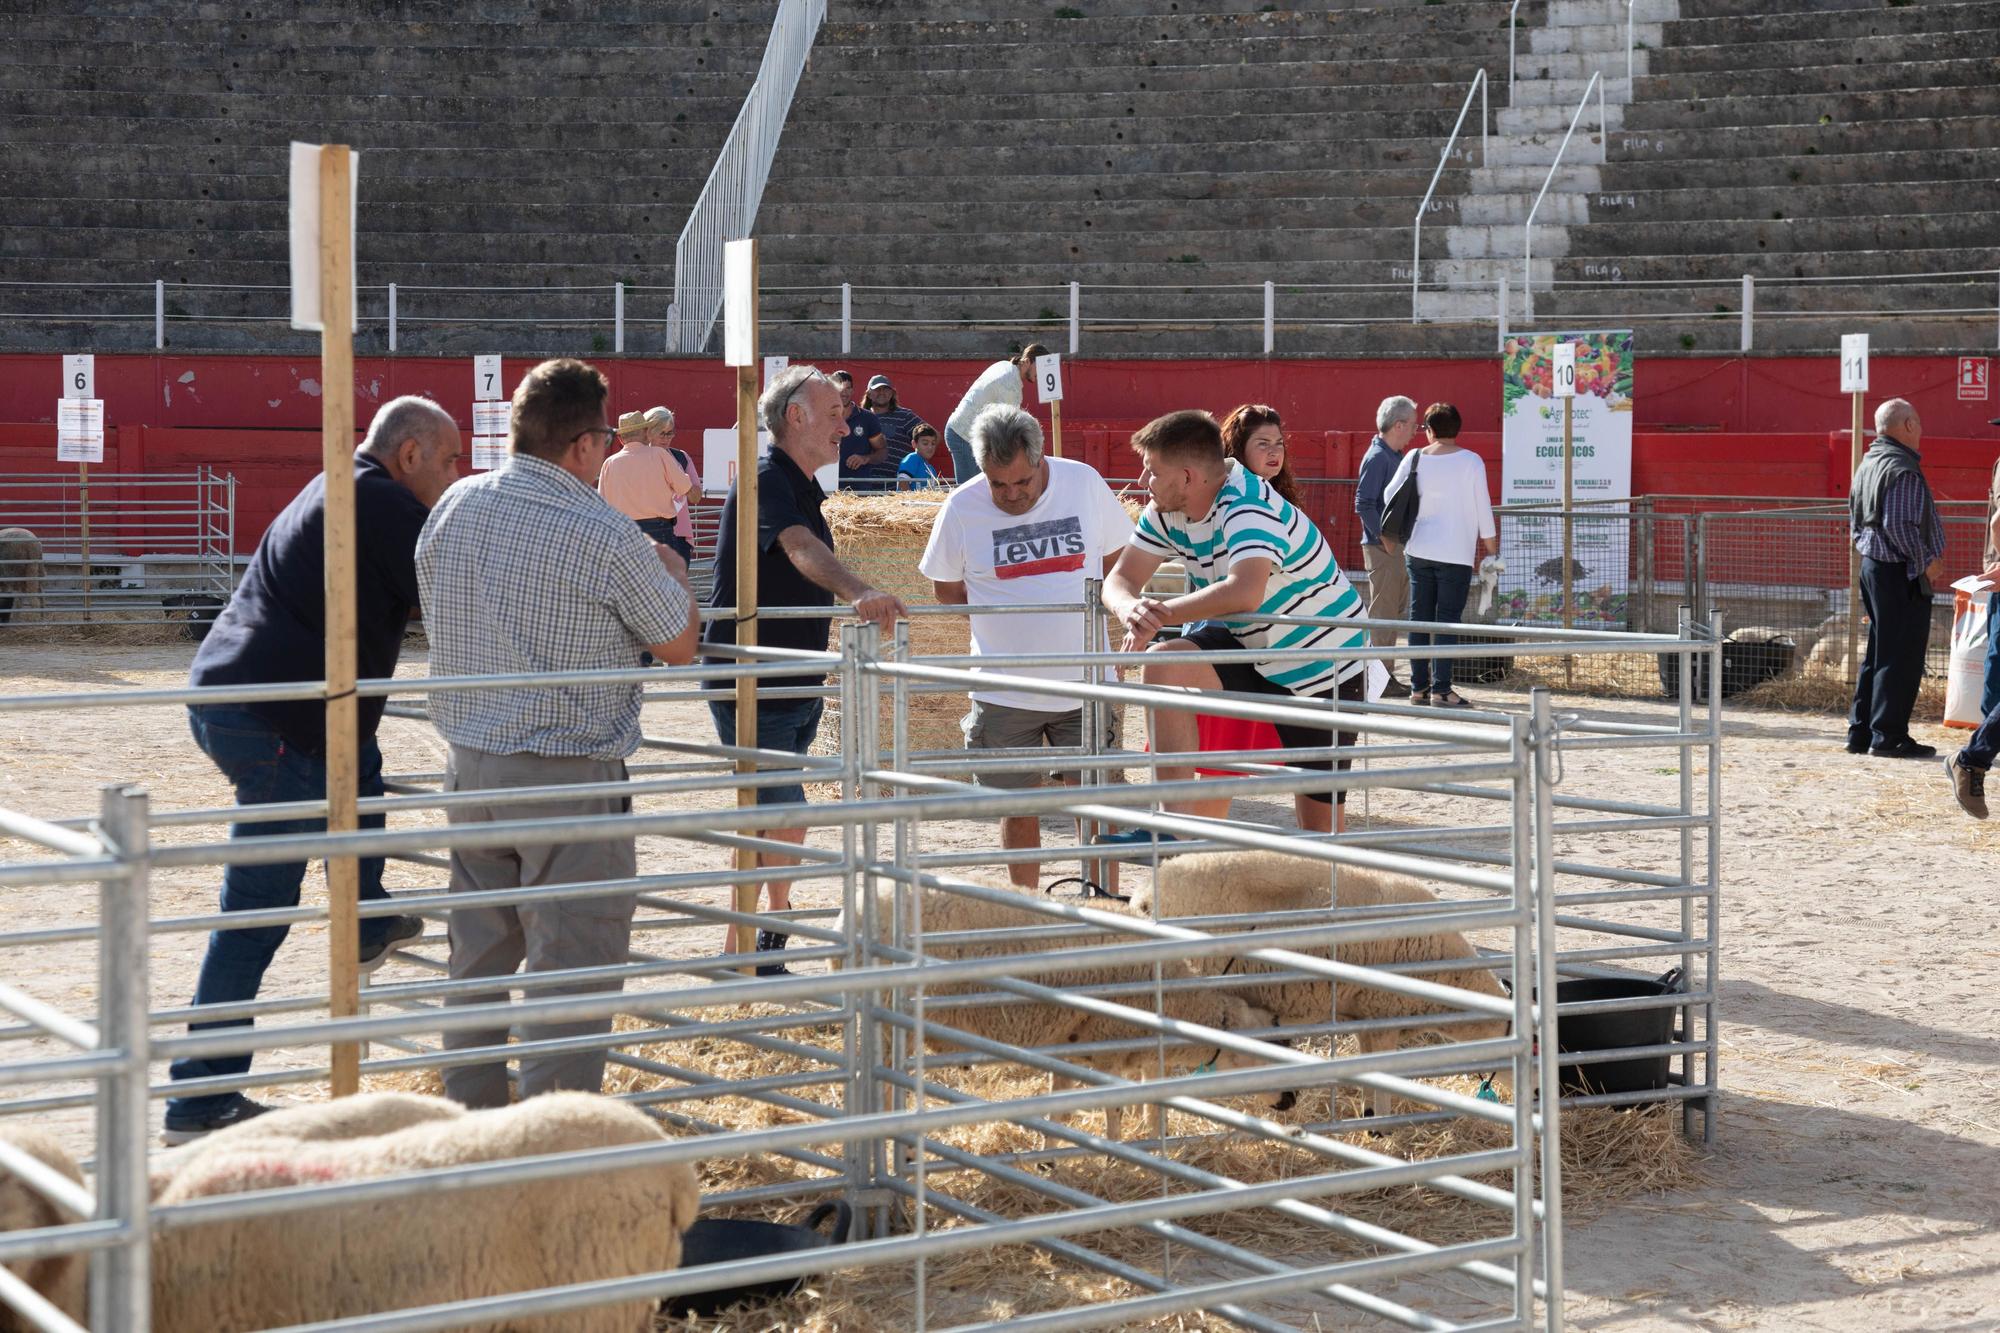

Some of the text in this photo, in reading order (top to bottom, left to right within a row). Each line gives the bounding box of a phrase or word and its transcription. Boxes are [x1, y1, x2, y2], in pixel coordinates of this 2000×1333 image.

[1623, 138, 1664, 152] FILA 6
[1446, 201, 1454, 212] 4
[1600, 195, 1635, 208] FILA 4
[1585, 265, 1622, 281] FILA 2
[1557, 364, 1574, 386] 10
[1845, 357, 1862, 380] 11
[74, 372, 87, 390] 6
[484, 373, 495, 391] 7
[1045, 373, 1056, 392] 9
[1535, 443, 1595, 458] ECOLÓICOS
